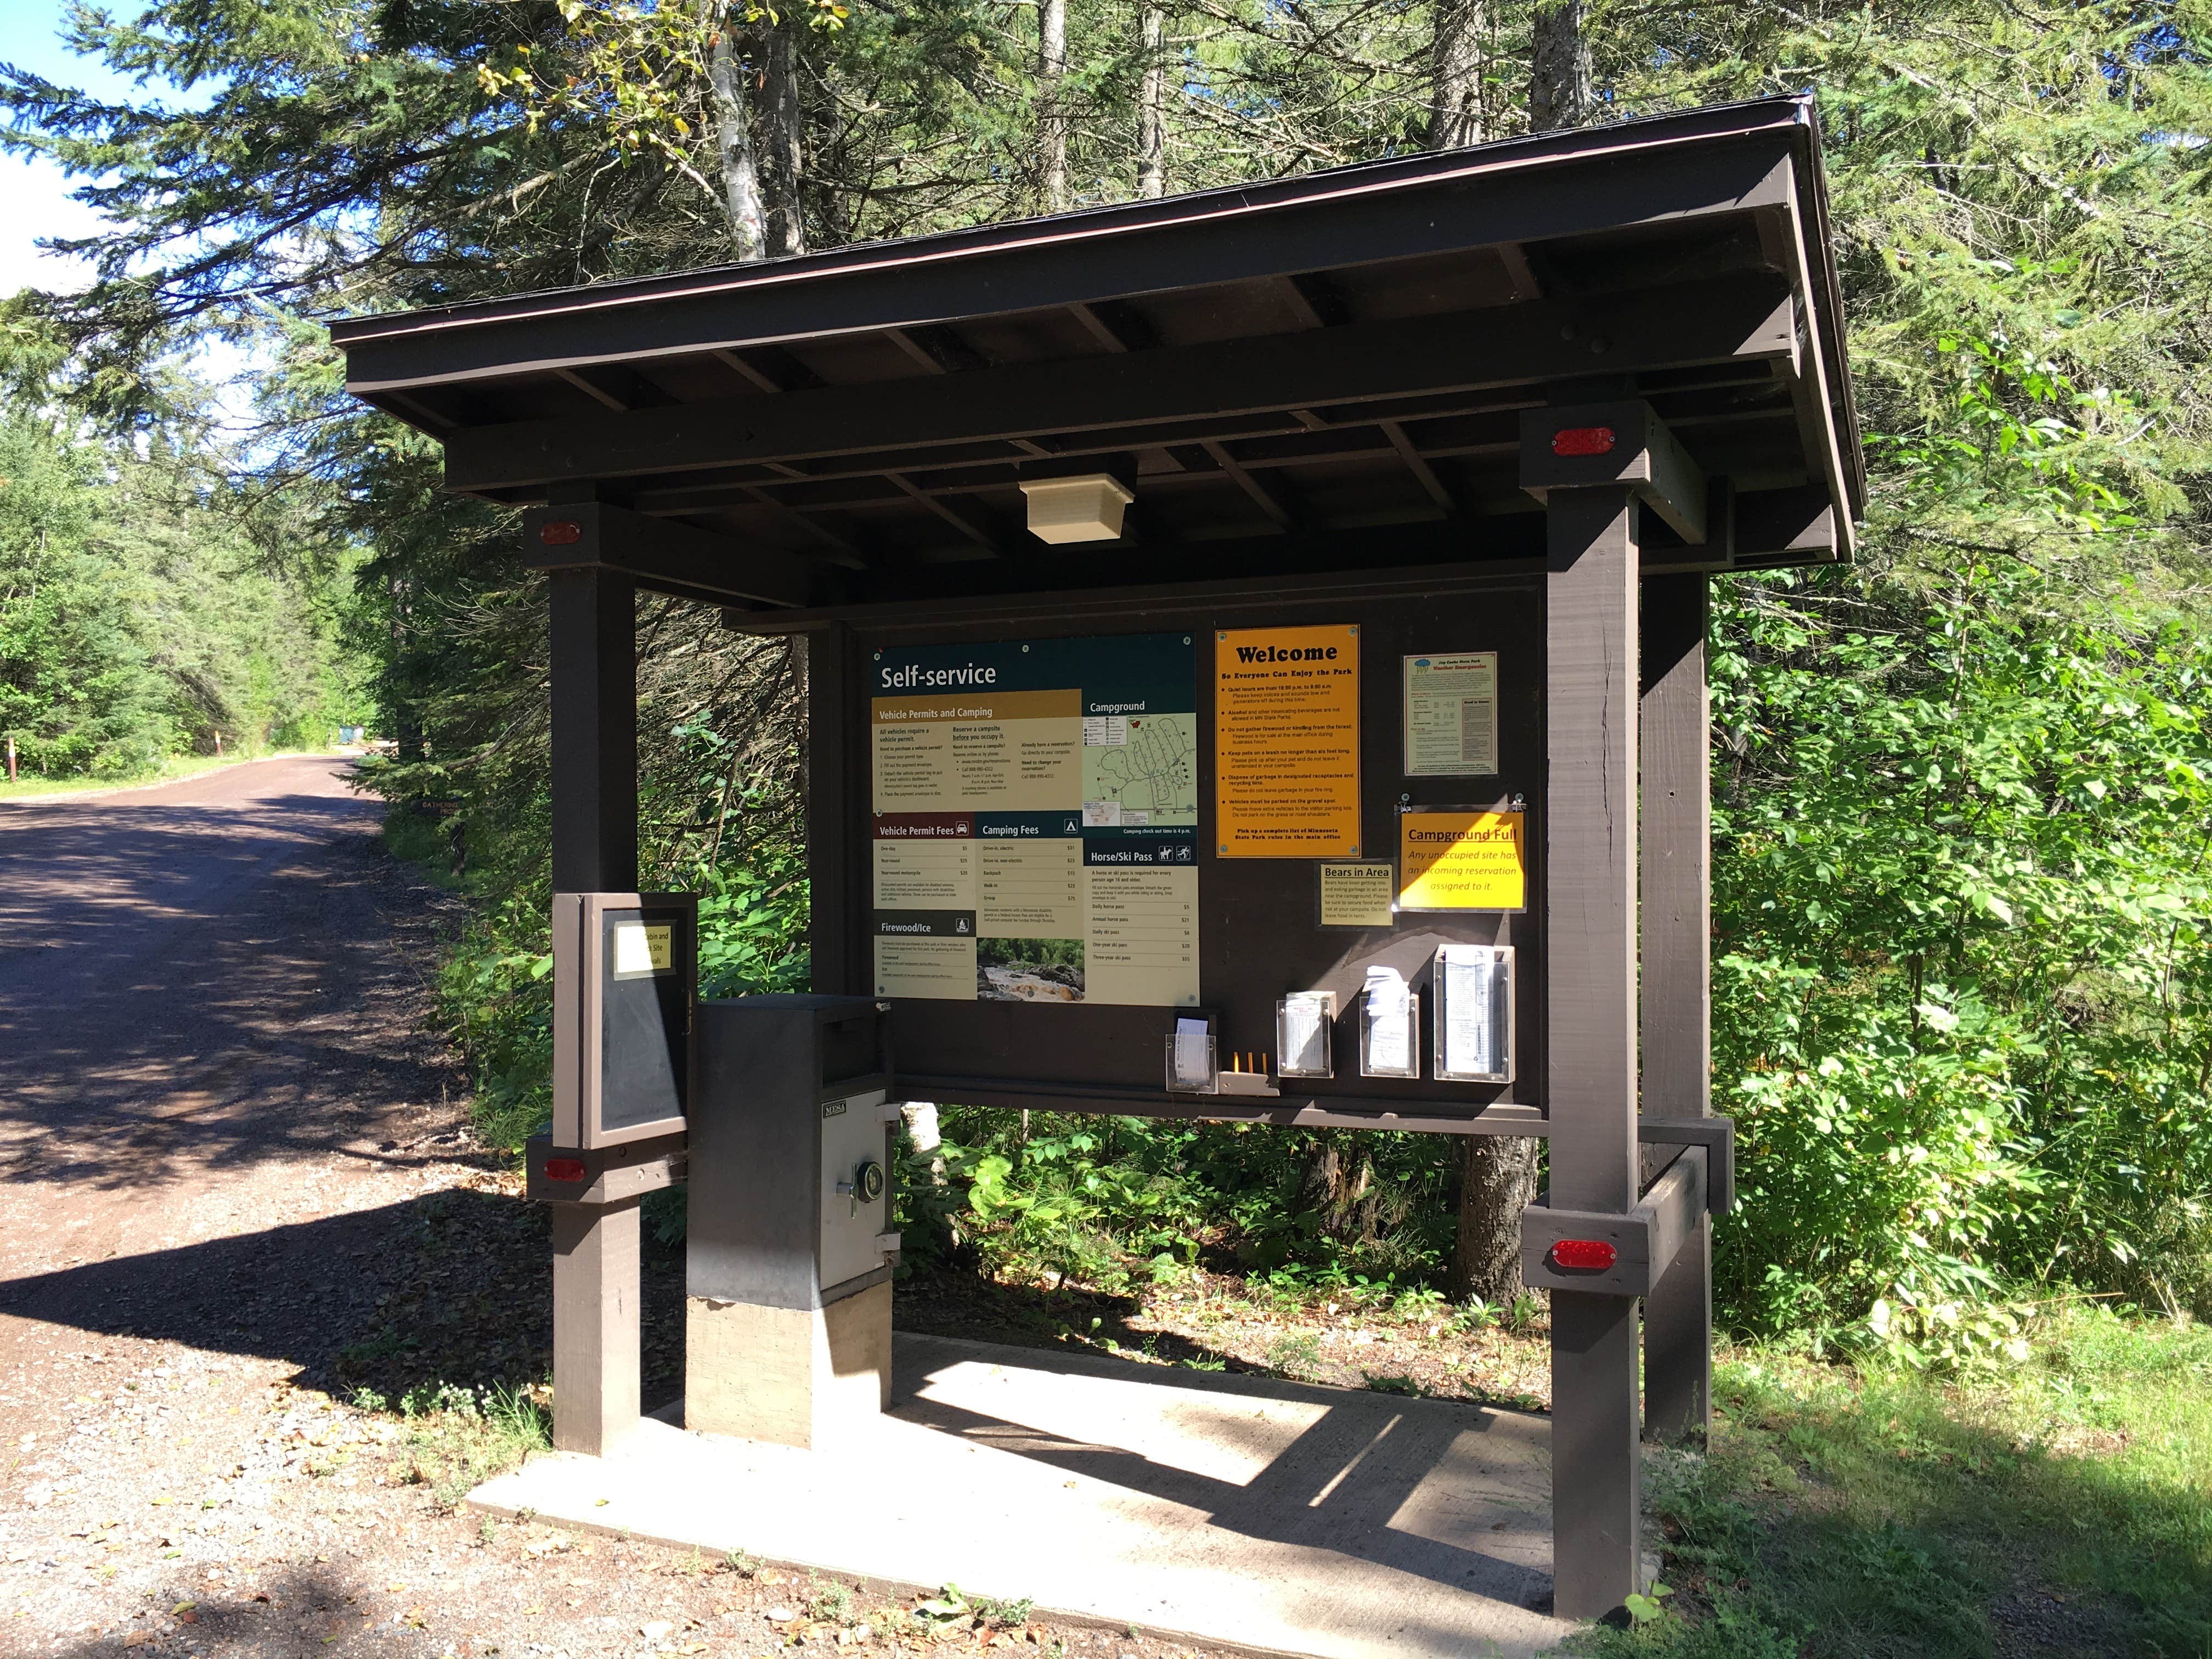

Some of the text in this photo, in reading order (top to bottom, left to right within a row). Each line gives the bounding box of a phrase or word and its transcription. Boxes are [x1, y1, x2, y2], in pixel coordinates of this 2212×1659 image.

[1236, 646, 1338, 664] Welcome
[882, 663, 996, 688] Self-service
[1090, 701, 1144, 713] Campground
[879, 707, 992, 719] Vehicle Permits and Camping
[880, 826, 954, 835] Vehicle Permit Fees
[983, 825, 1039, 836] Camping Fees
[1408, 828, 1517, 842] Campground Full
[1092, 851, 1152, 861] Horse/Ski Pass
[1408, 850, 1426, 860] Any
[1426, 849, 1479, 861] unoccupied
[1500, 849, 1517, 859] has
[1325, 867, 1389, 877] Bears in Area
[1420, 866, 1463, 877] incoming
[1431, 882, 1470, 891] assigned
[882, 923, 931, 932] Firewood/Ice
[825, 1103, 845, 1116] MESA
